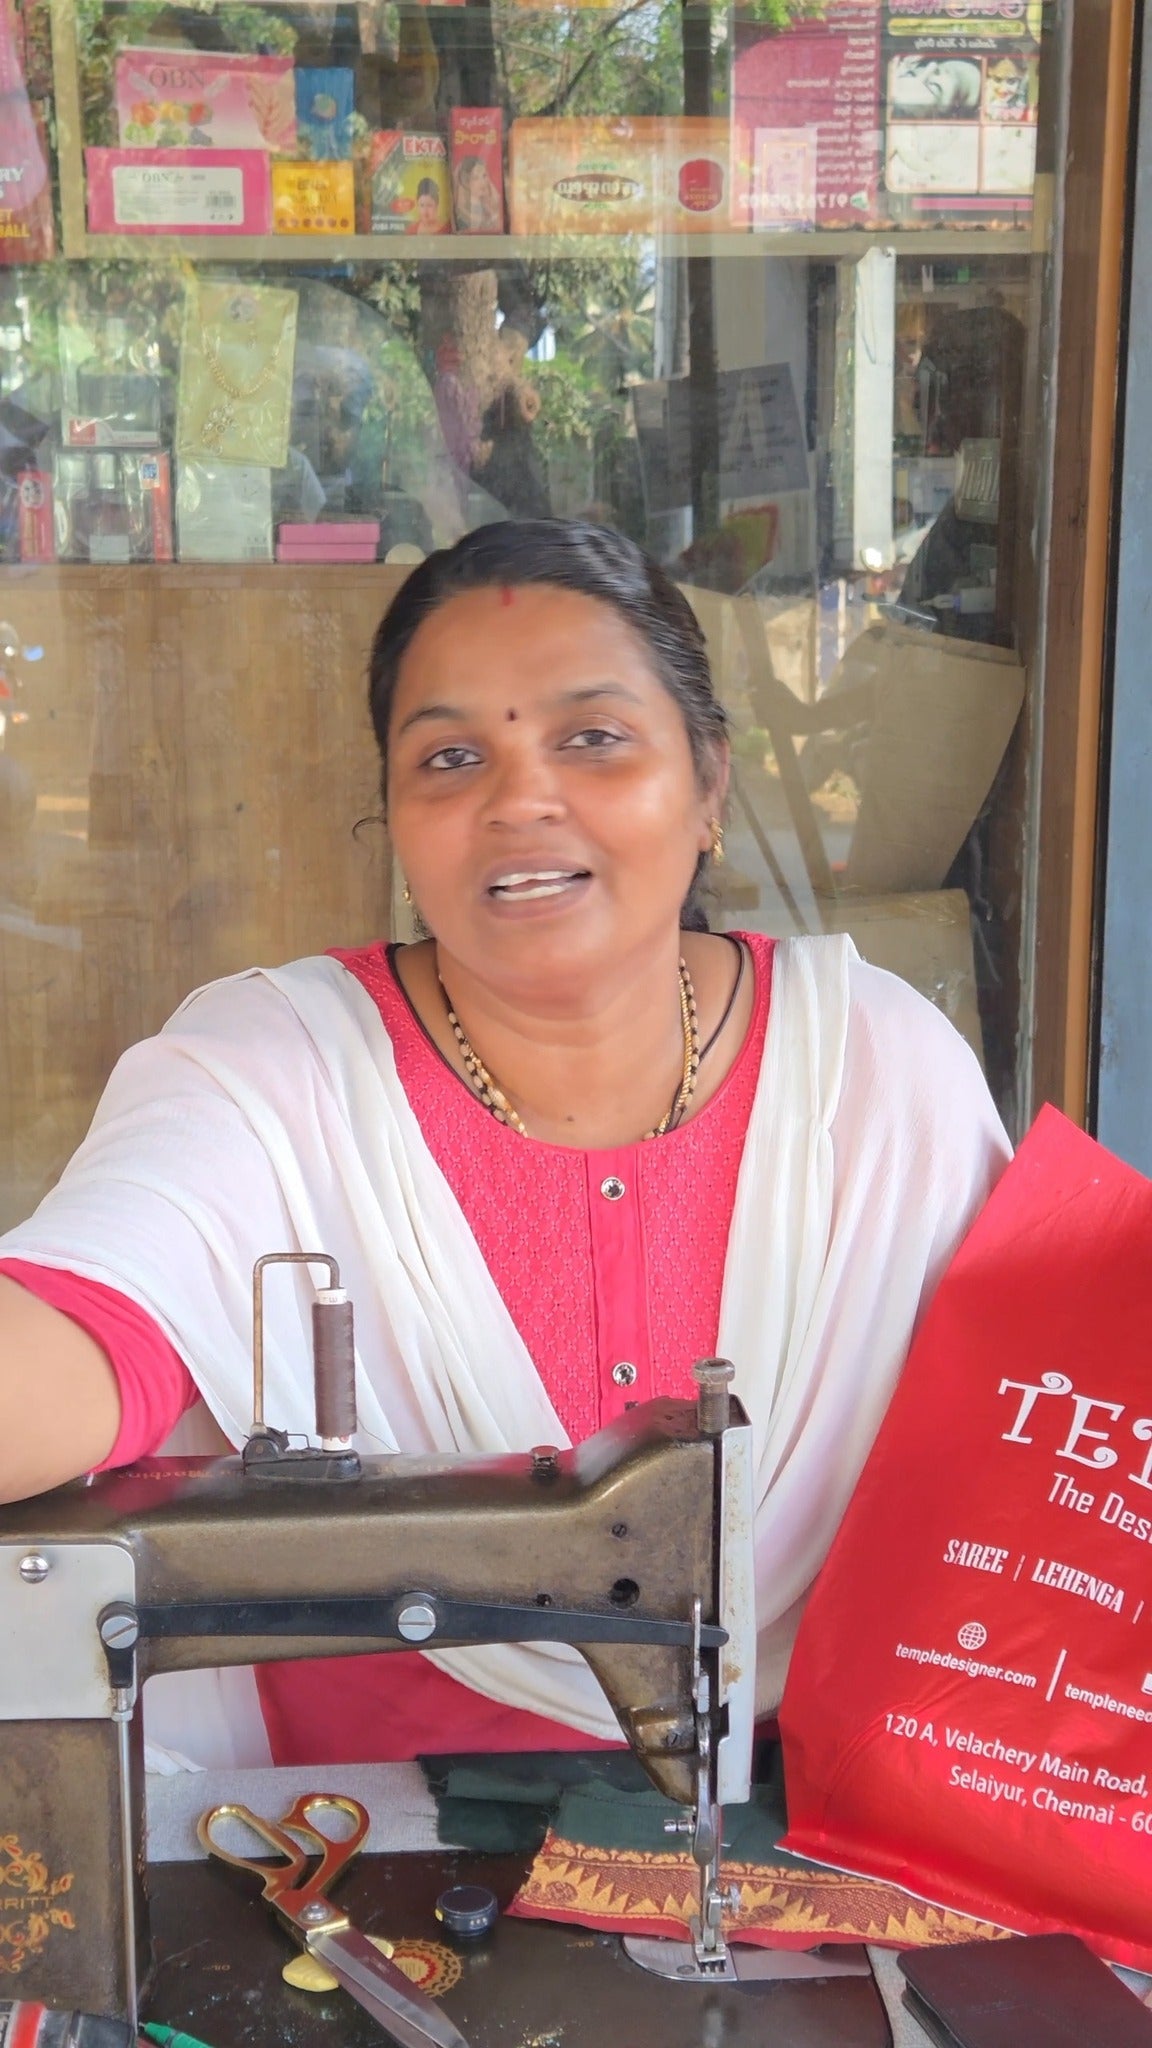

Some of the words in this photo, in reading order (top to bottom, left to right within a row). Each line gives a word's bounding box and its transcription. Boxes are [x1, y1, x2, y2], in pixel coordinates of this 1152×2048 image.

[149, 67, 204, 88] OBN
[402, 136, 447, 158] EKTA
[1048, 1472, 1095, 1514] The
[1099, 1491, 1152, 1545] Des
[943, 1538, 1009, 1574] SAREE
[1031, 1558, 1126, 1614] LEHENGA
[895, 1643, 1038, 1688] templedesigner.com
[885, 1712, 918, 1738] 120
[918, 1722, 938, 1747] A,
[944, 1726, 1038, 1773] Velachery
[1038, 1752, 1091, 1784] Main
[1092, 1768, 1149, 1799] Road,
[948, 1765, 1028, 1807] Selaiyur,
[1031, 1787, 1115, 1826] Chennai
[0, 1896, 55, 1910] RITT
